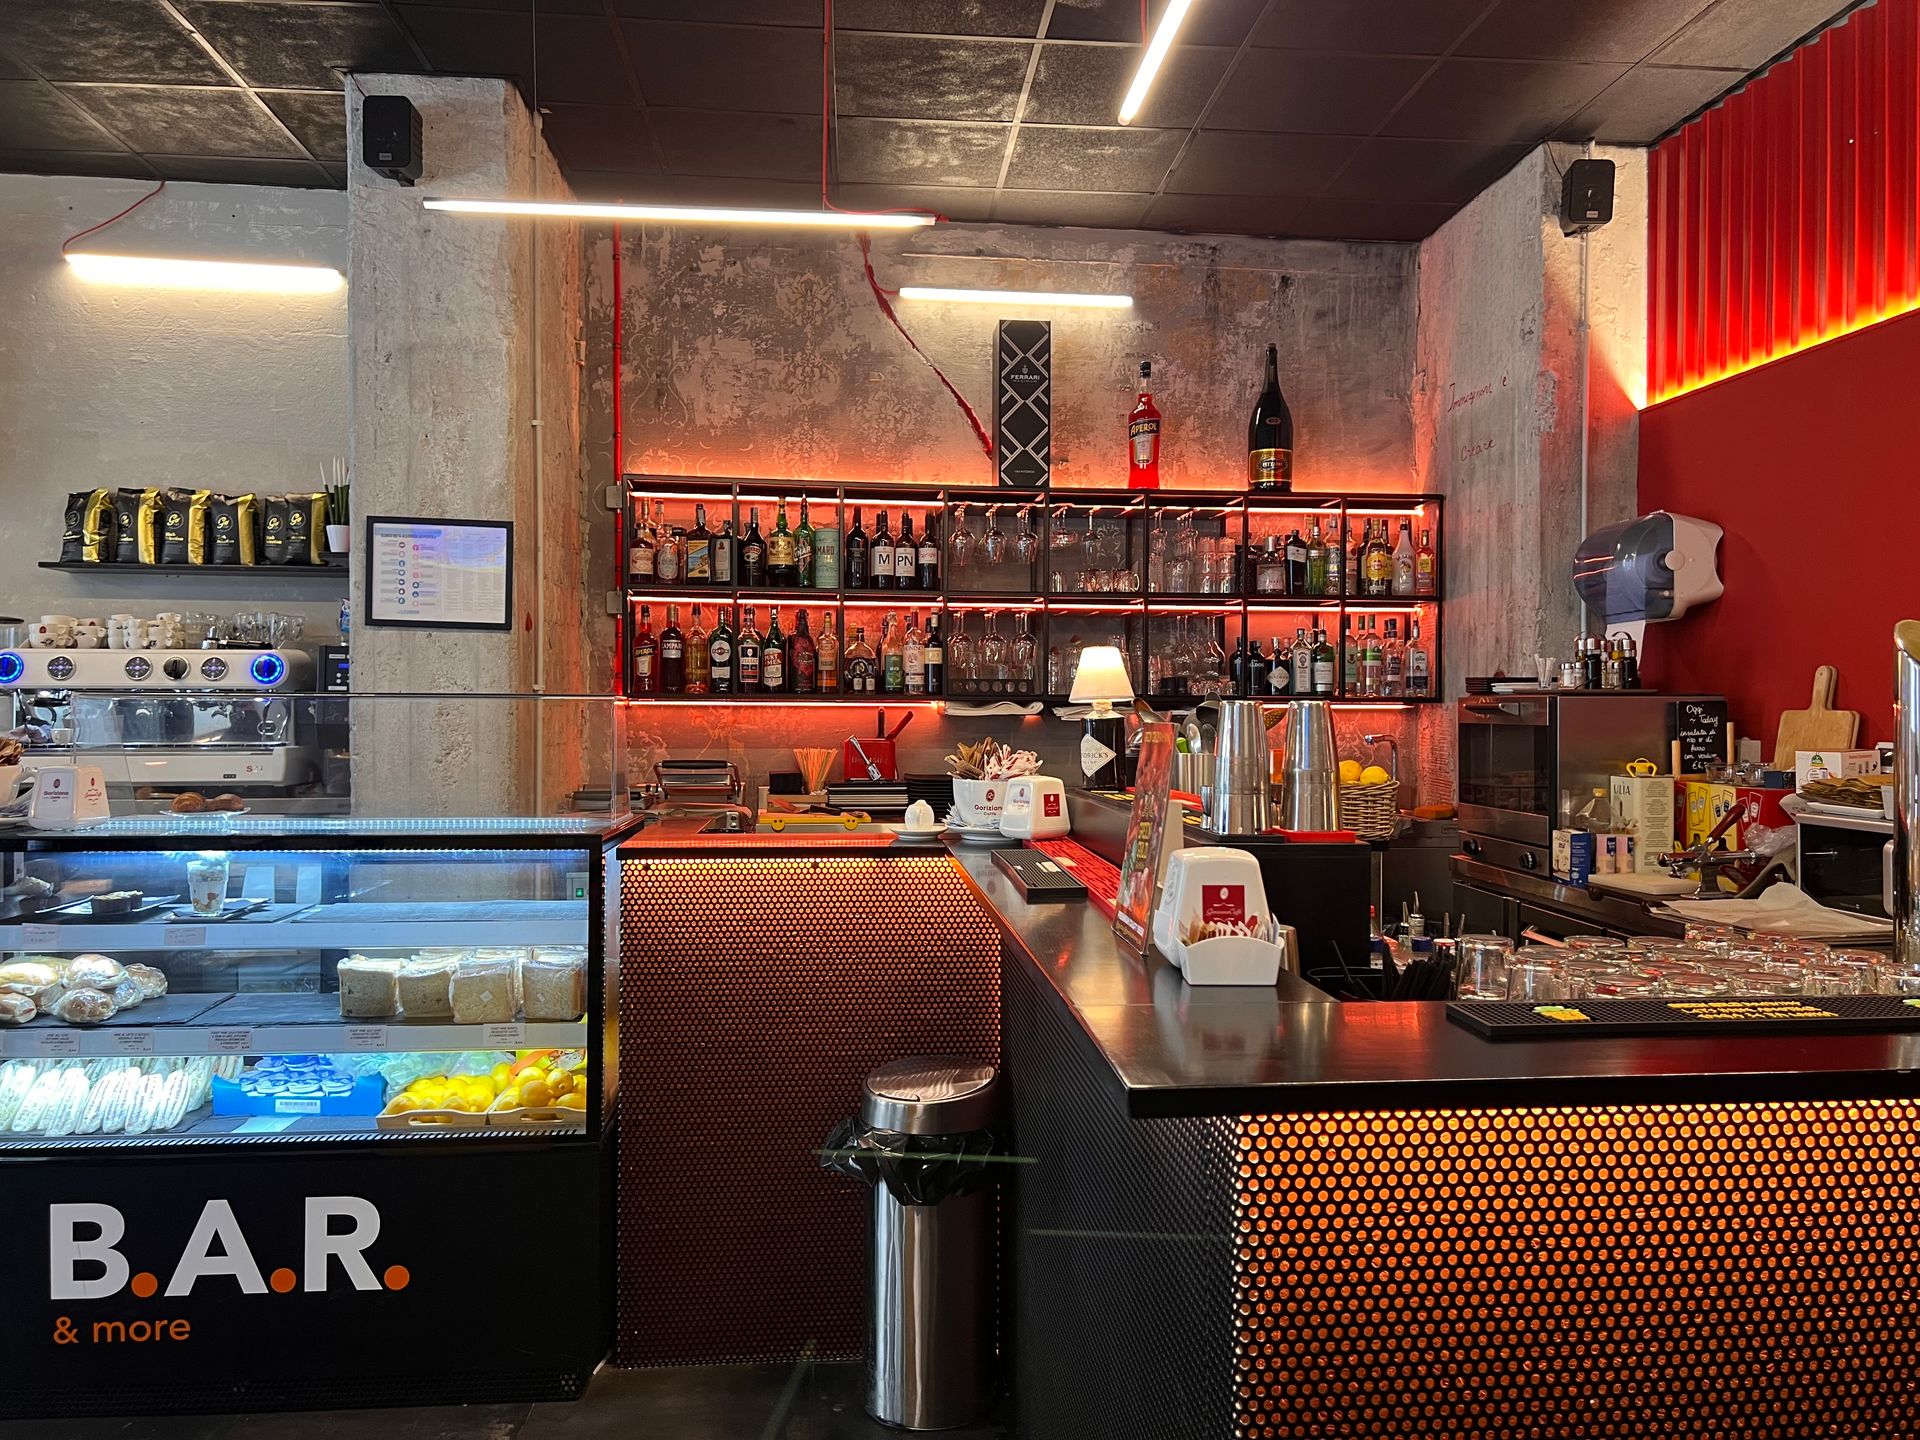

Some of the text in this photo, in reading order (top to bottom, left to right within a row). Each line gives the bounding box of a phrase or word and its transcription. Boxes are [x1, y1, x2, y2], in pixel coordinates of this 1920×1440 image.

[1130, 422, 1158, 436] APEROL
[879, 554, 890, 564] M
[897, 556, 913, 566] PN
[1686, 704, 1704, 715] Oggi
[1699, 714, 1718, 727] Today
[50, 1196, 410, 1300] B.A.R.
[53, 1316, 192, 1345] & more
